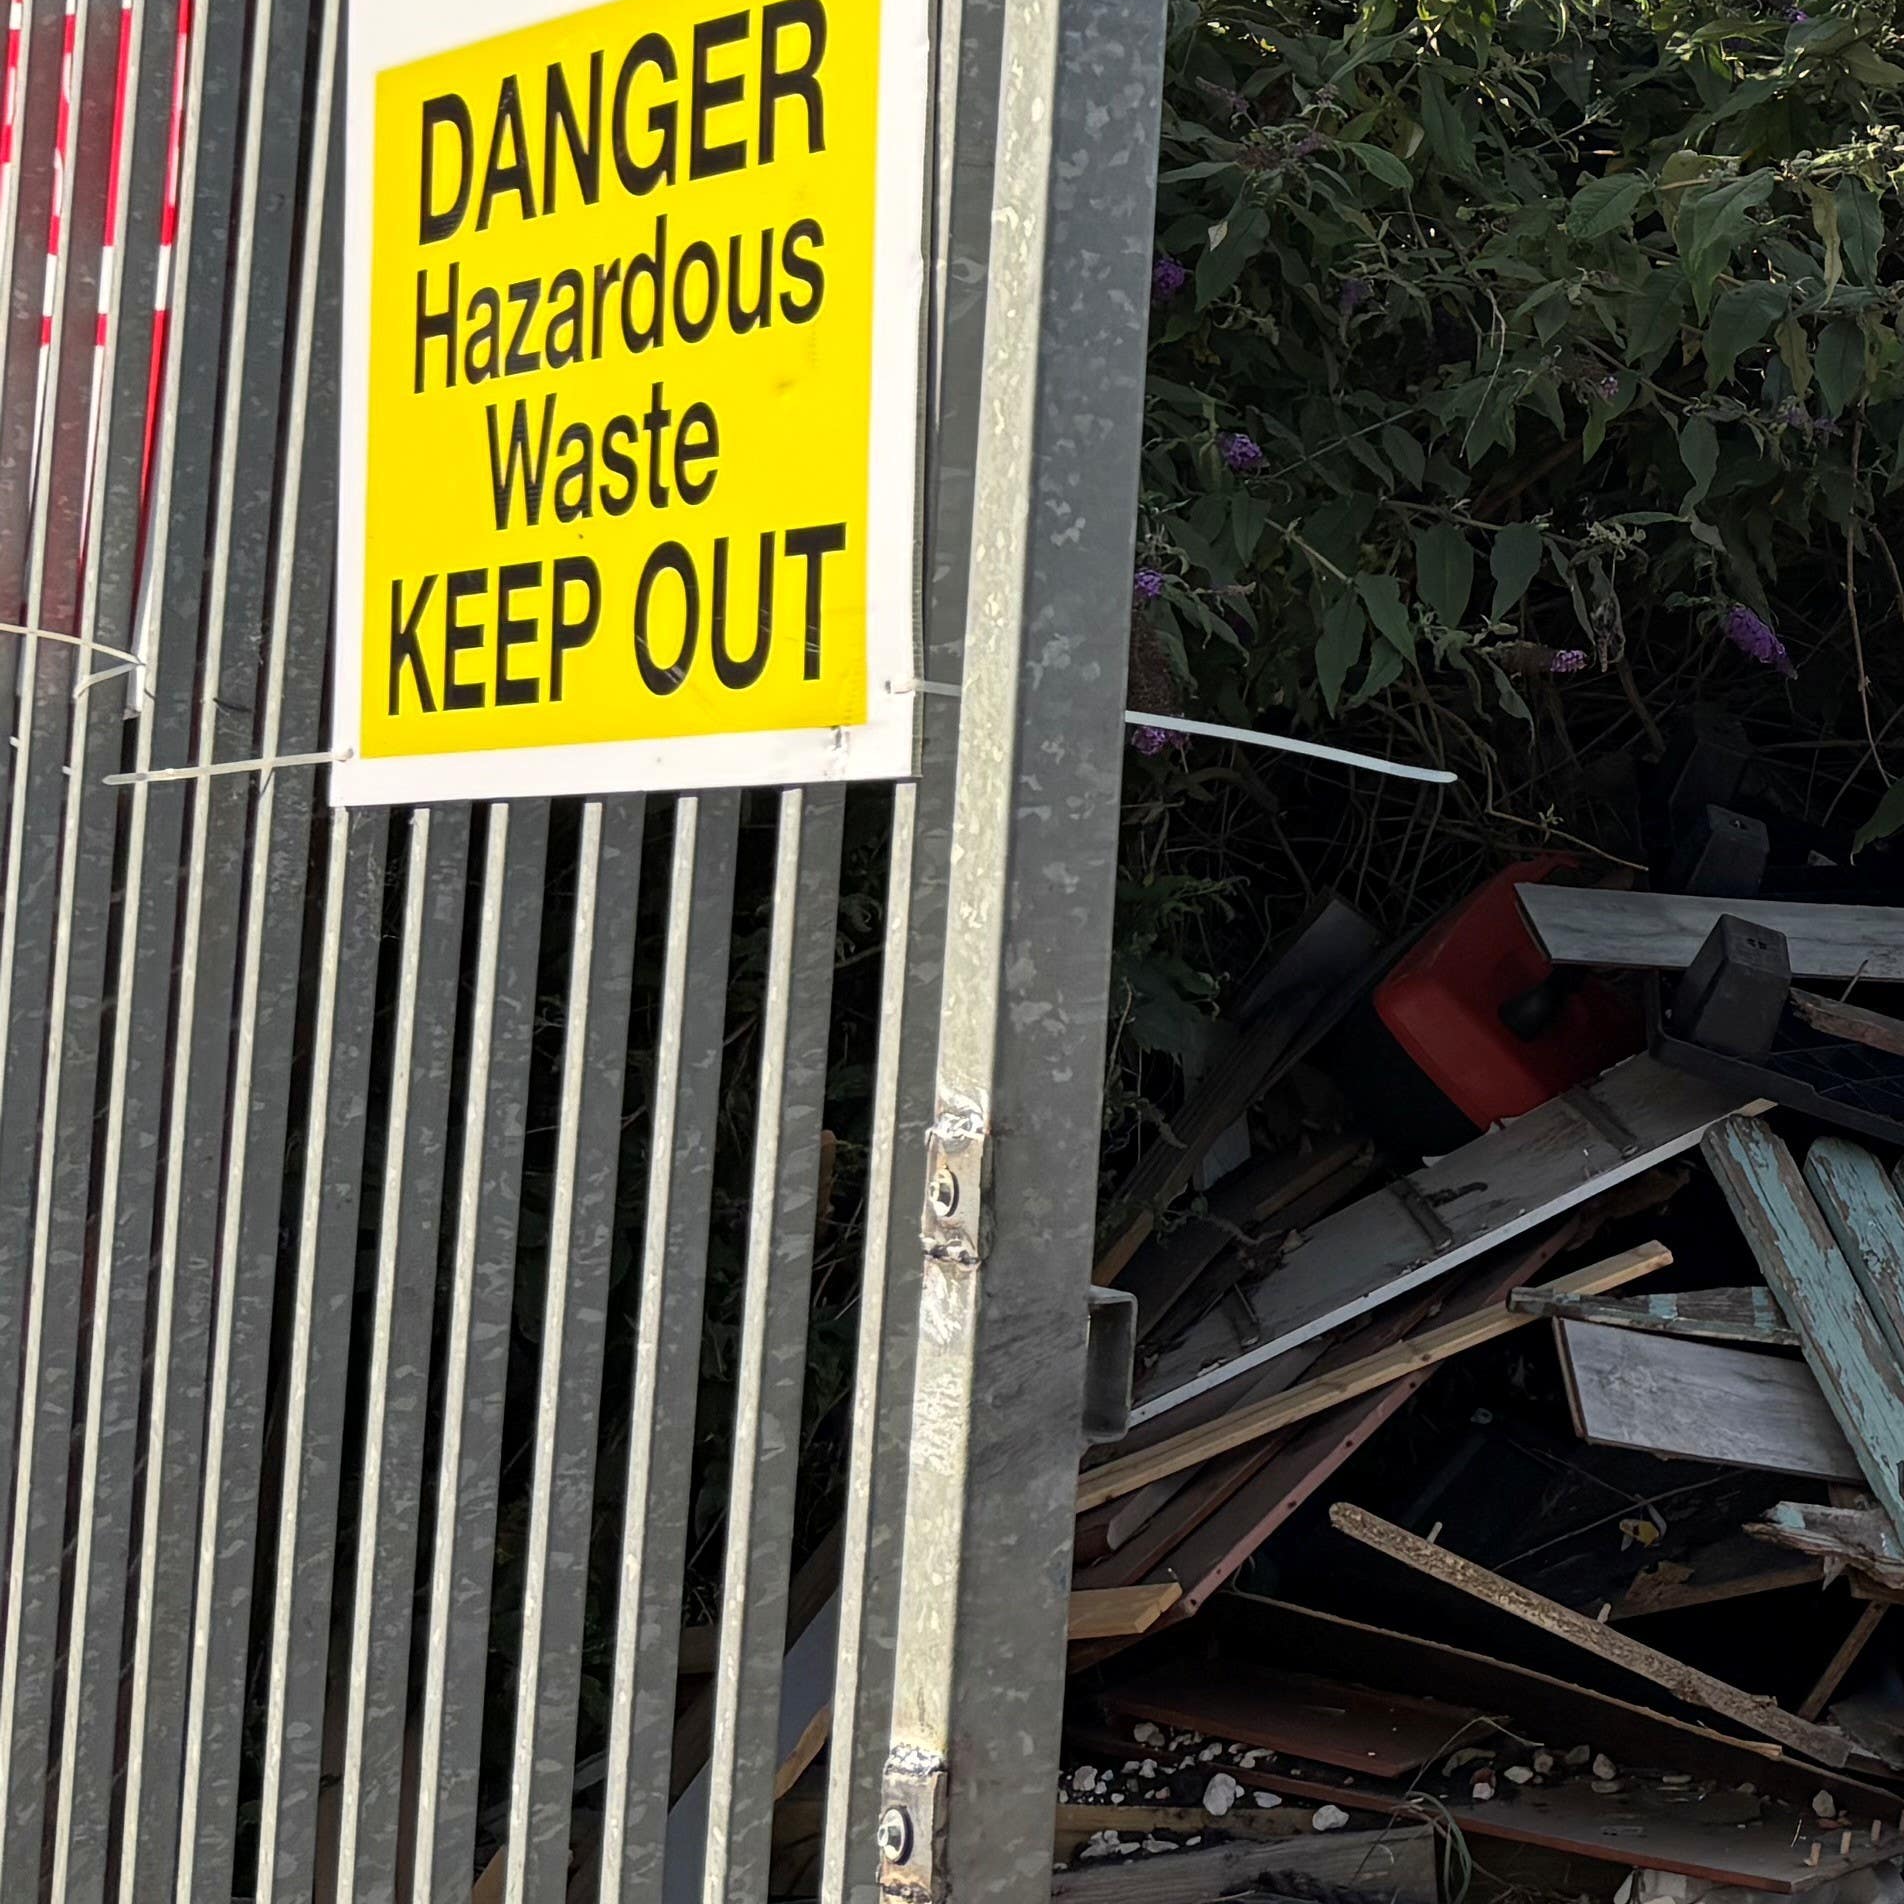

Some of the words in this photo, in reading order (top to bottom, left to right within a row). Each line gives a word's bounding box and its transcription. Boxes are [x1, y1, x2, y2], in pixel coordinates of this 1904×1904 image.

[413, 213, 825, 395] Hazardous
[485, 381, 720, 532] Waste
[387, 553, 602, 717] KEEP
[632, 521, 847, 697] OUT
